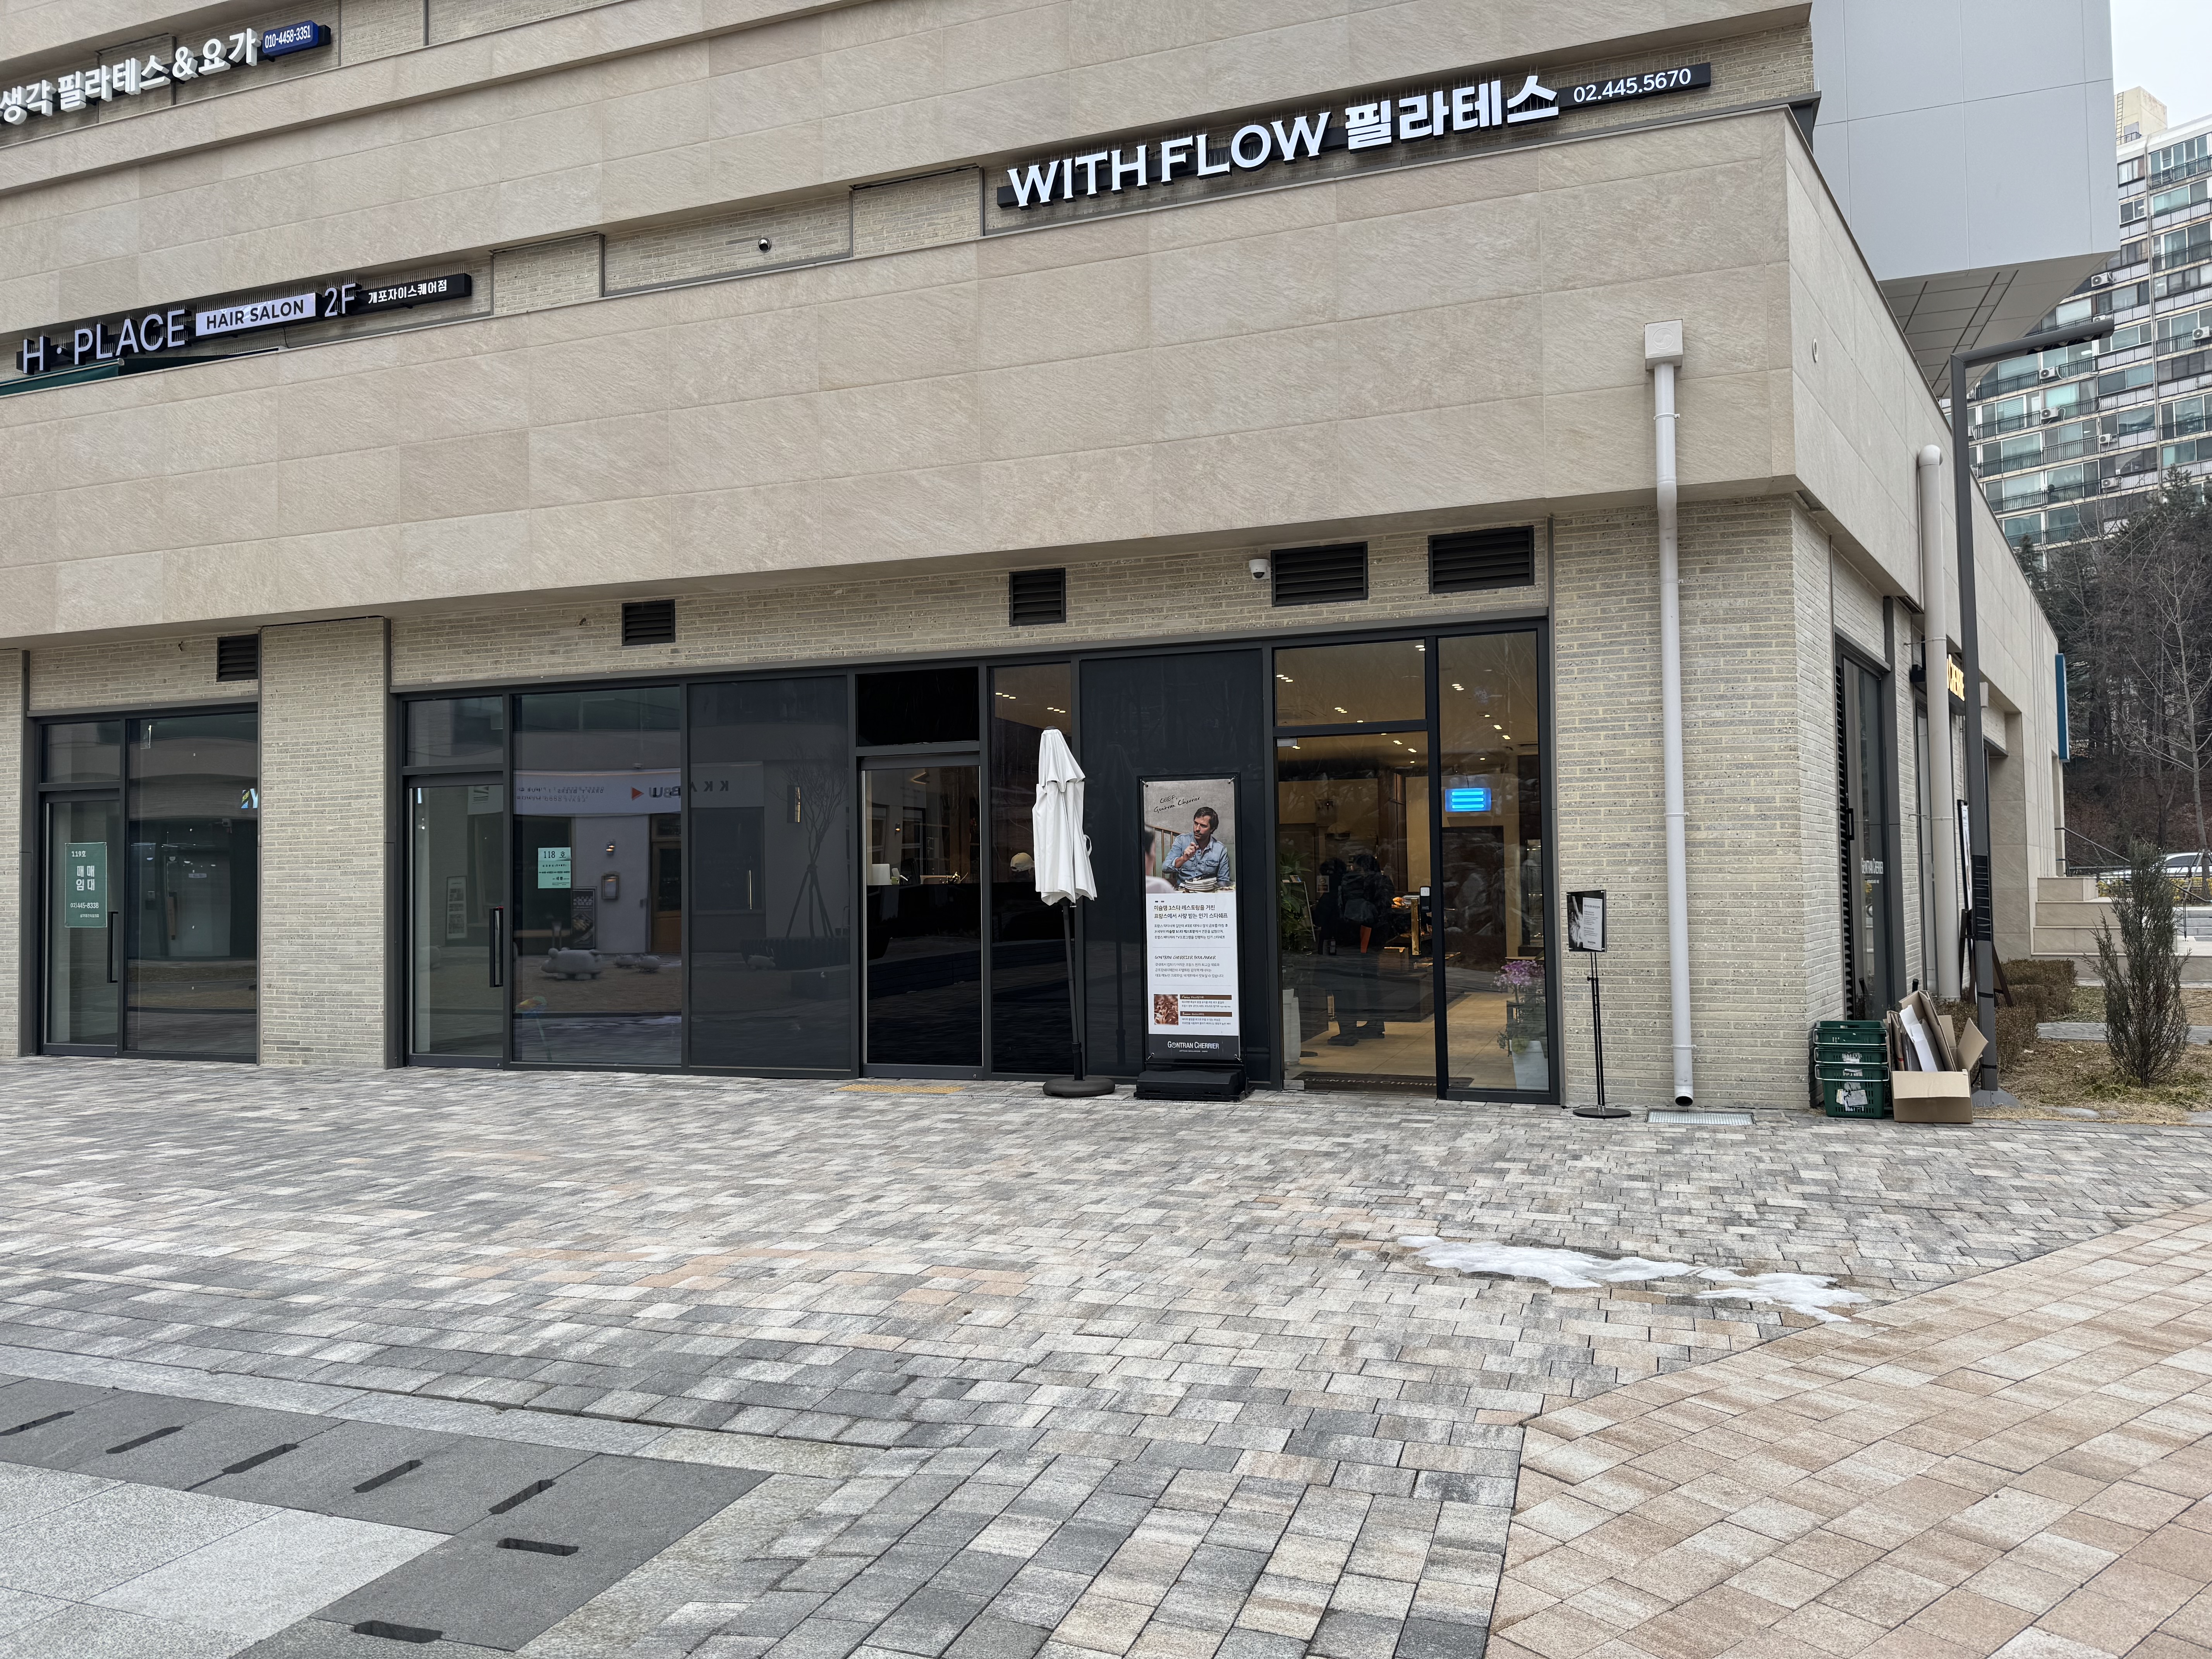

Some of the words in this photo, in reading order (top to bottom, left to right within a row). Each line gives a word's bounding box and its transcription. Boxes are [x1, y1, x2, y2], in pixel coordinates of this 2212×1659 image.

[265, 25, 311, 48] 010-4458-3351
[1573, 68, 1692, 103] 02.445.5670
[1007, 144, 1149, 208] WITH
[1161, 111, 1331, 183] FLOW
[1345, 75, 1559, 150] 필라테스
[325, 283, 356, 317] 2F
[368, 279, 448, 304] 개포자이스퀘어점
[207, 311, 244, 330] HAIR
[250, 299, 304, 322] SALON
